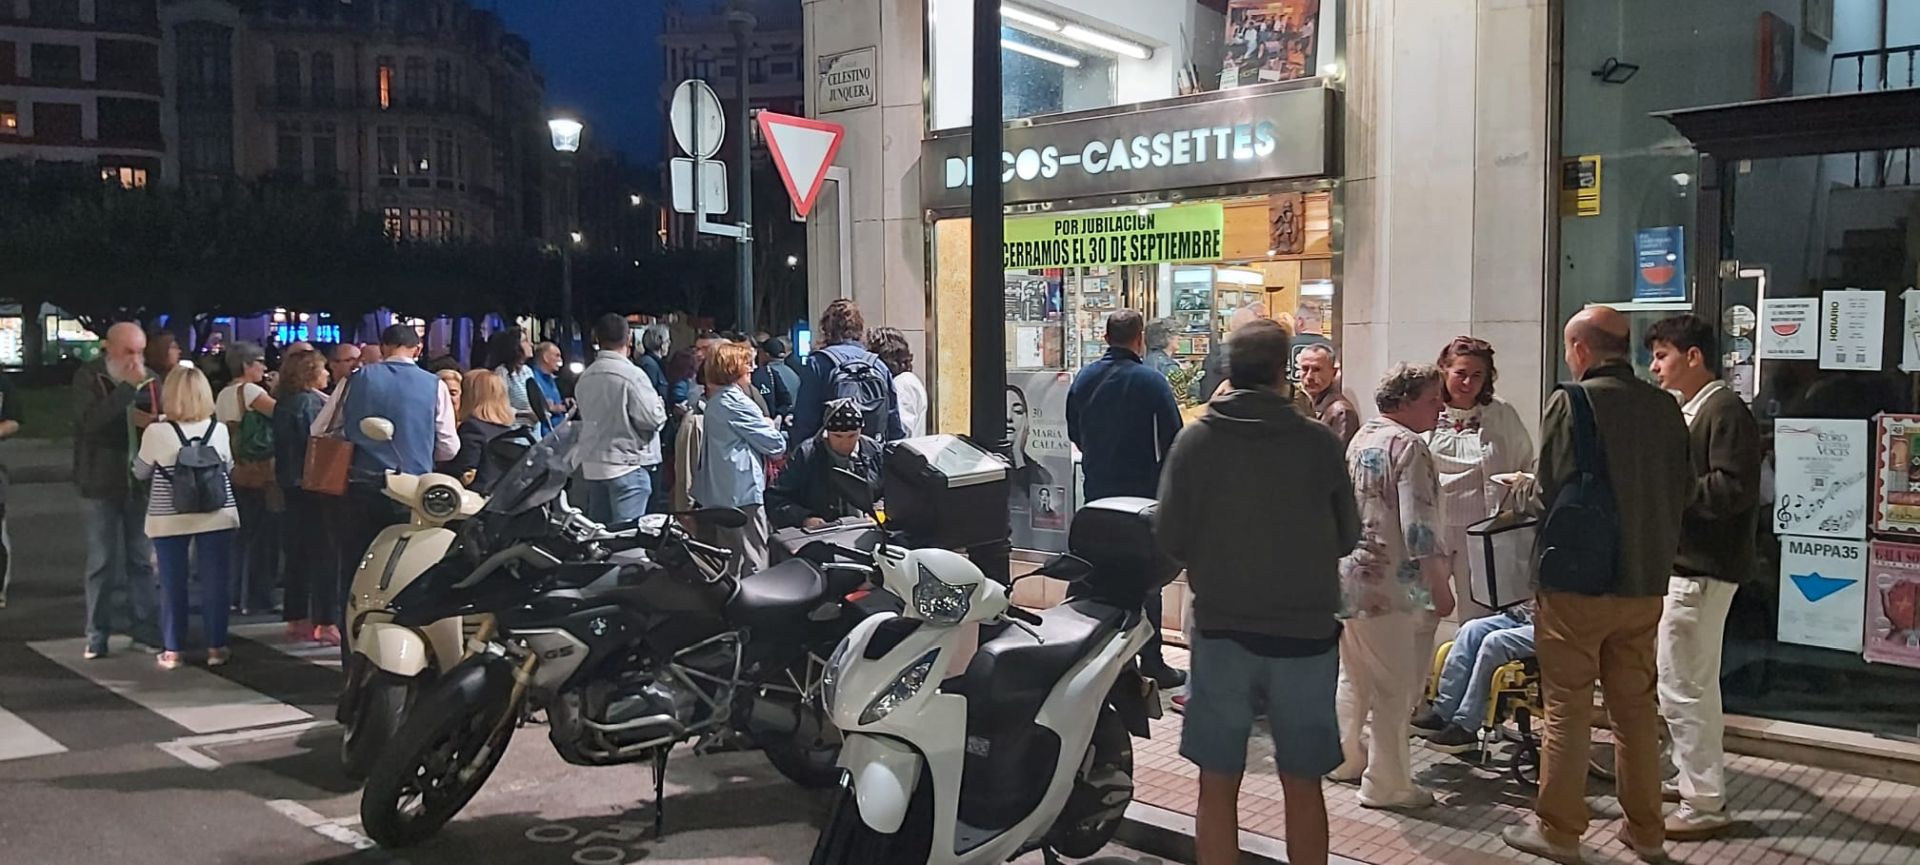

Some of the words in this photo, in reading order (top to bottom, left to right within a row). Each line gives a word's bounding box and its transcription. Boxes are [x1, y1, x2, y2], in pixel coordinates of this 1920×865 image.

[827, 67, 871, 86] CELESTINO
[829, 84, 870, 102] JUNQUERA
[945, 120, 1276, 189] DICOS-CASSETTES
[1054, 219, 1079, 236] POR
[1002, 239, 1069, 267] CERRAMOS
[1072, 237, 1086, 264] EL
[1089, 236, 1107, 263] 30
[1110, 235, 1127, 262] DE
[1130, 229, 1220, 261] SEPTIEMBRE
[1829, 301, 1840, 342] HORARIO
[1789, 541, 1859, 560] MAPPA35
[544, 645, 574, 659] GS
